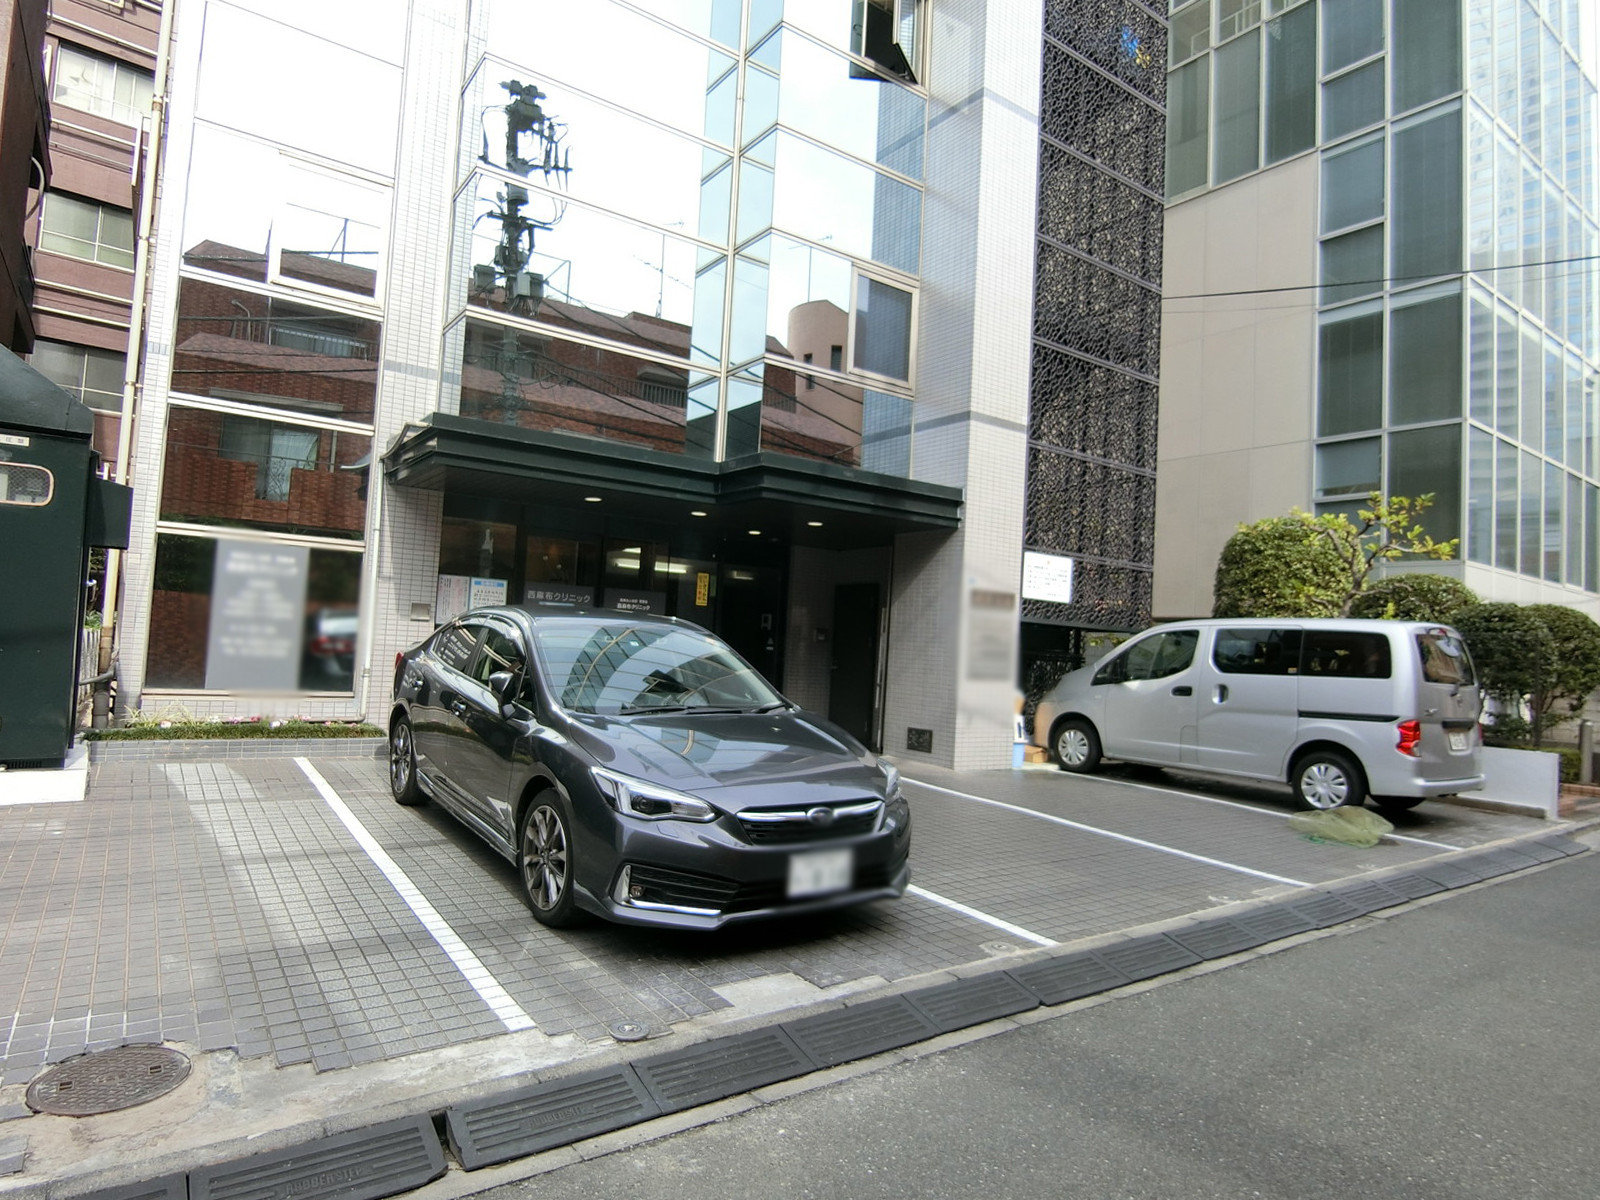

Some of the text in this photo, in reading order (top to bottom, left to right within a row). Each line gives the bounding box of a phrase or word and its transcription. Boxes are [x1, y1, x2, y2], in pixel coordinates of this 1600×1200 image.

[527, 590, 591, 603] 西麻布クリニック
